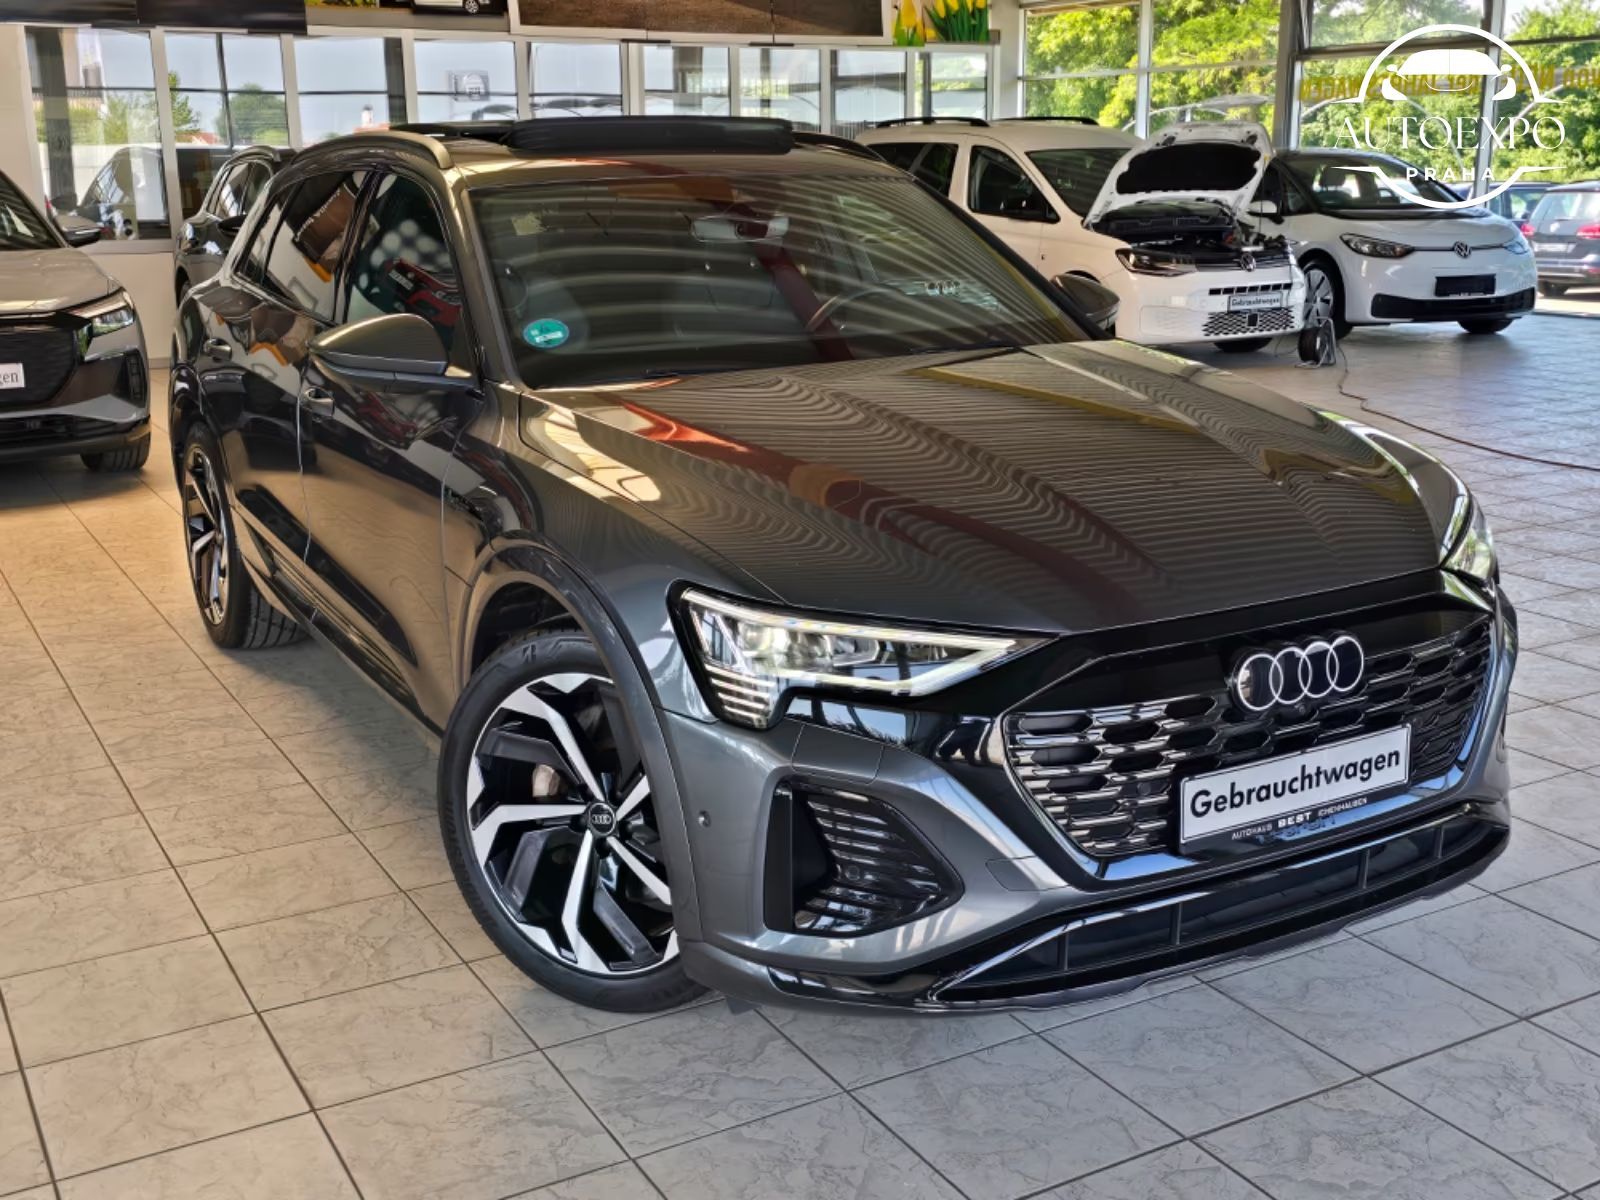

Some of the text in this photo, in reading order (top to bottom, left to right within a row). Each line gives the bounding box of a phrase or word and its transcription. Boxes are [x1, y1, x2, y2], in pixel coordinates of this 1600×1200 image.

[1190, 750, 1401, 818] Gebrauchtwagen
[1231, 823, 1273, 840] AUTOHAUS
[1277, 811, 1312, 829] BEST
